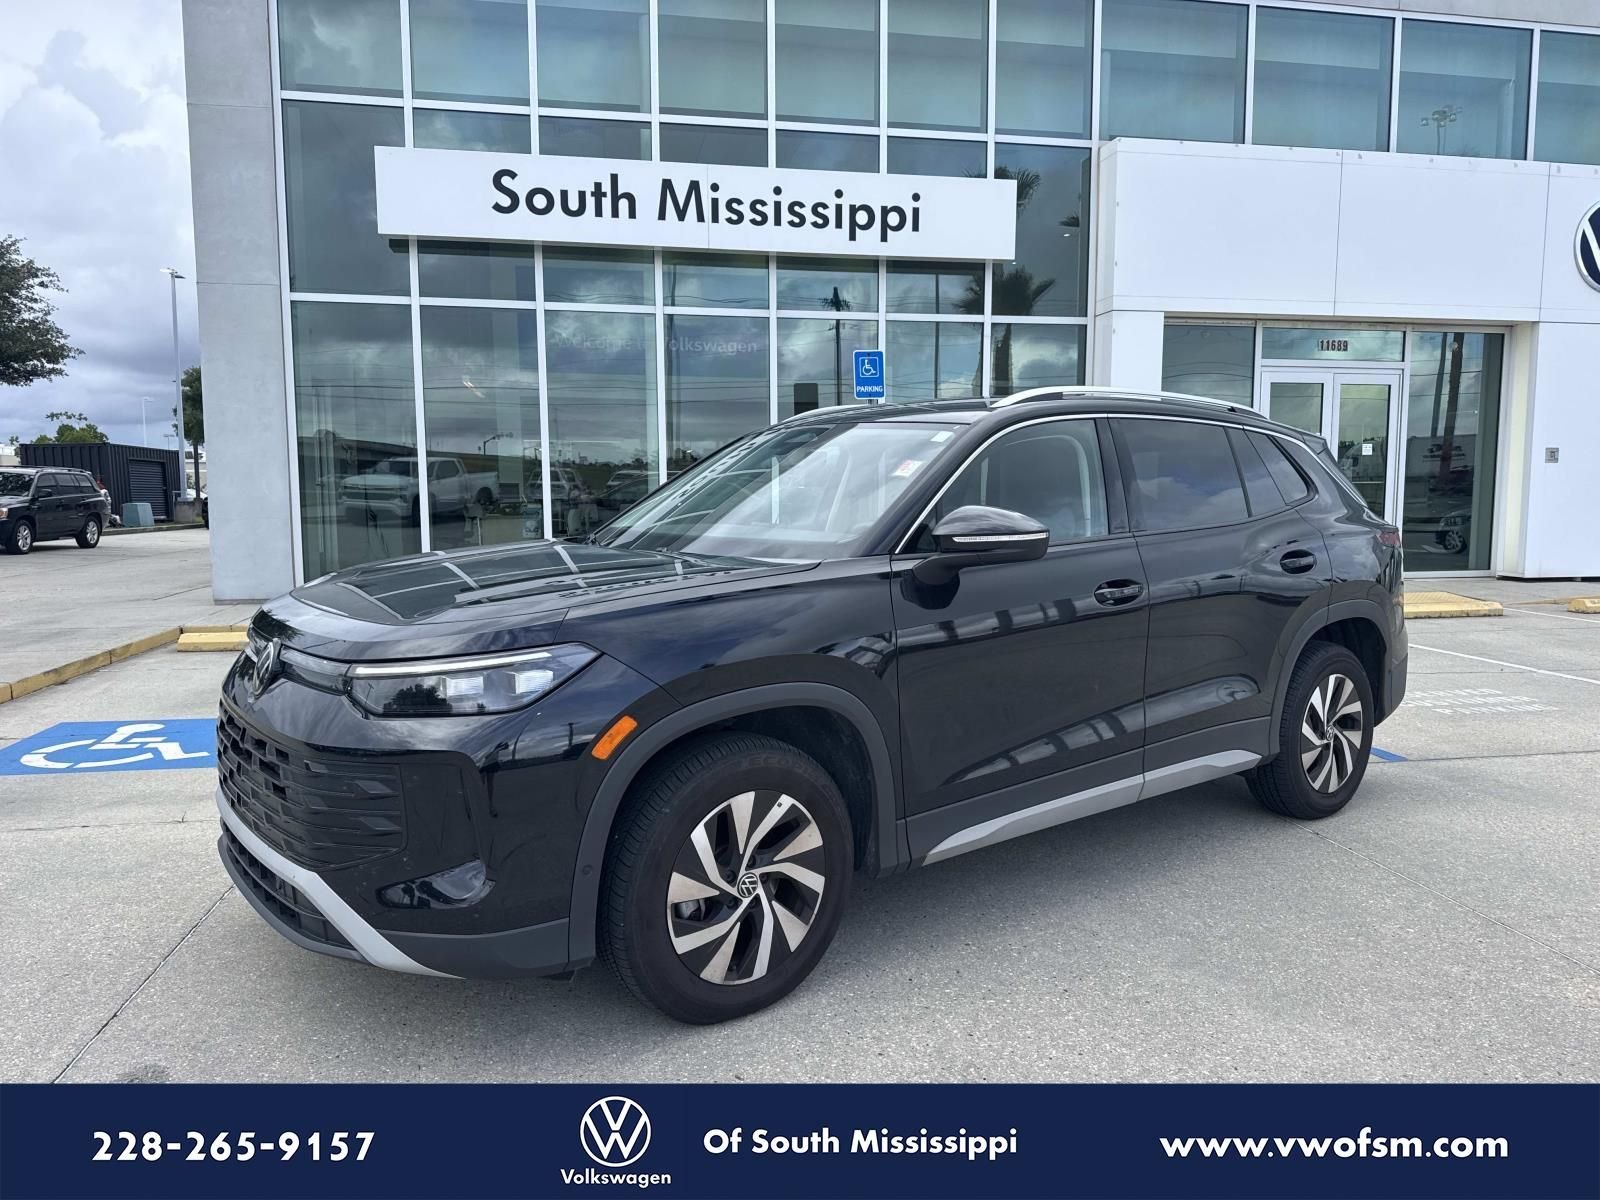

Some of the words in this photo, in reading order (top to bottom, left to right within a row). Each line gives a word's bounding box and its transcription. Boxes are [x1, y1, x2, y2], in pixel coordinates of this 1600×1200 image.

[491, 168, 637, 220] South
[657, 178, 921, 243] Mississippi
[1319, 339, 1349, 352] 11689
[856, 385, 884, 393] PARKING
